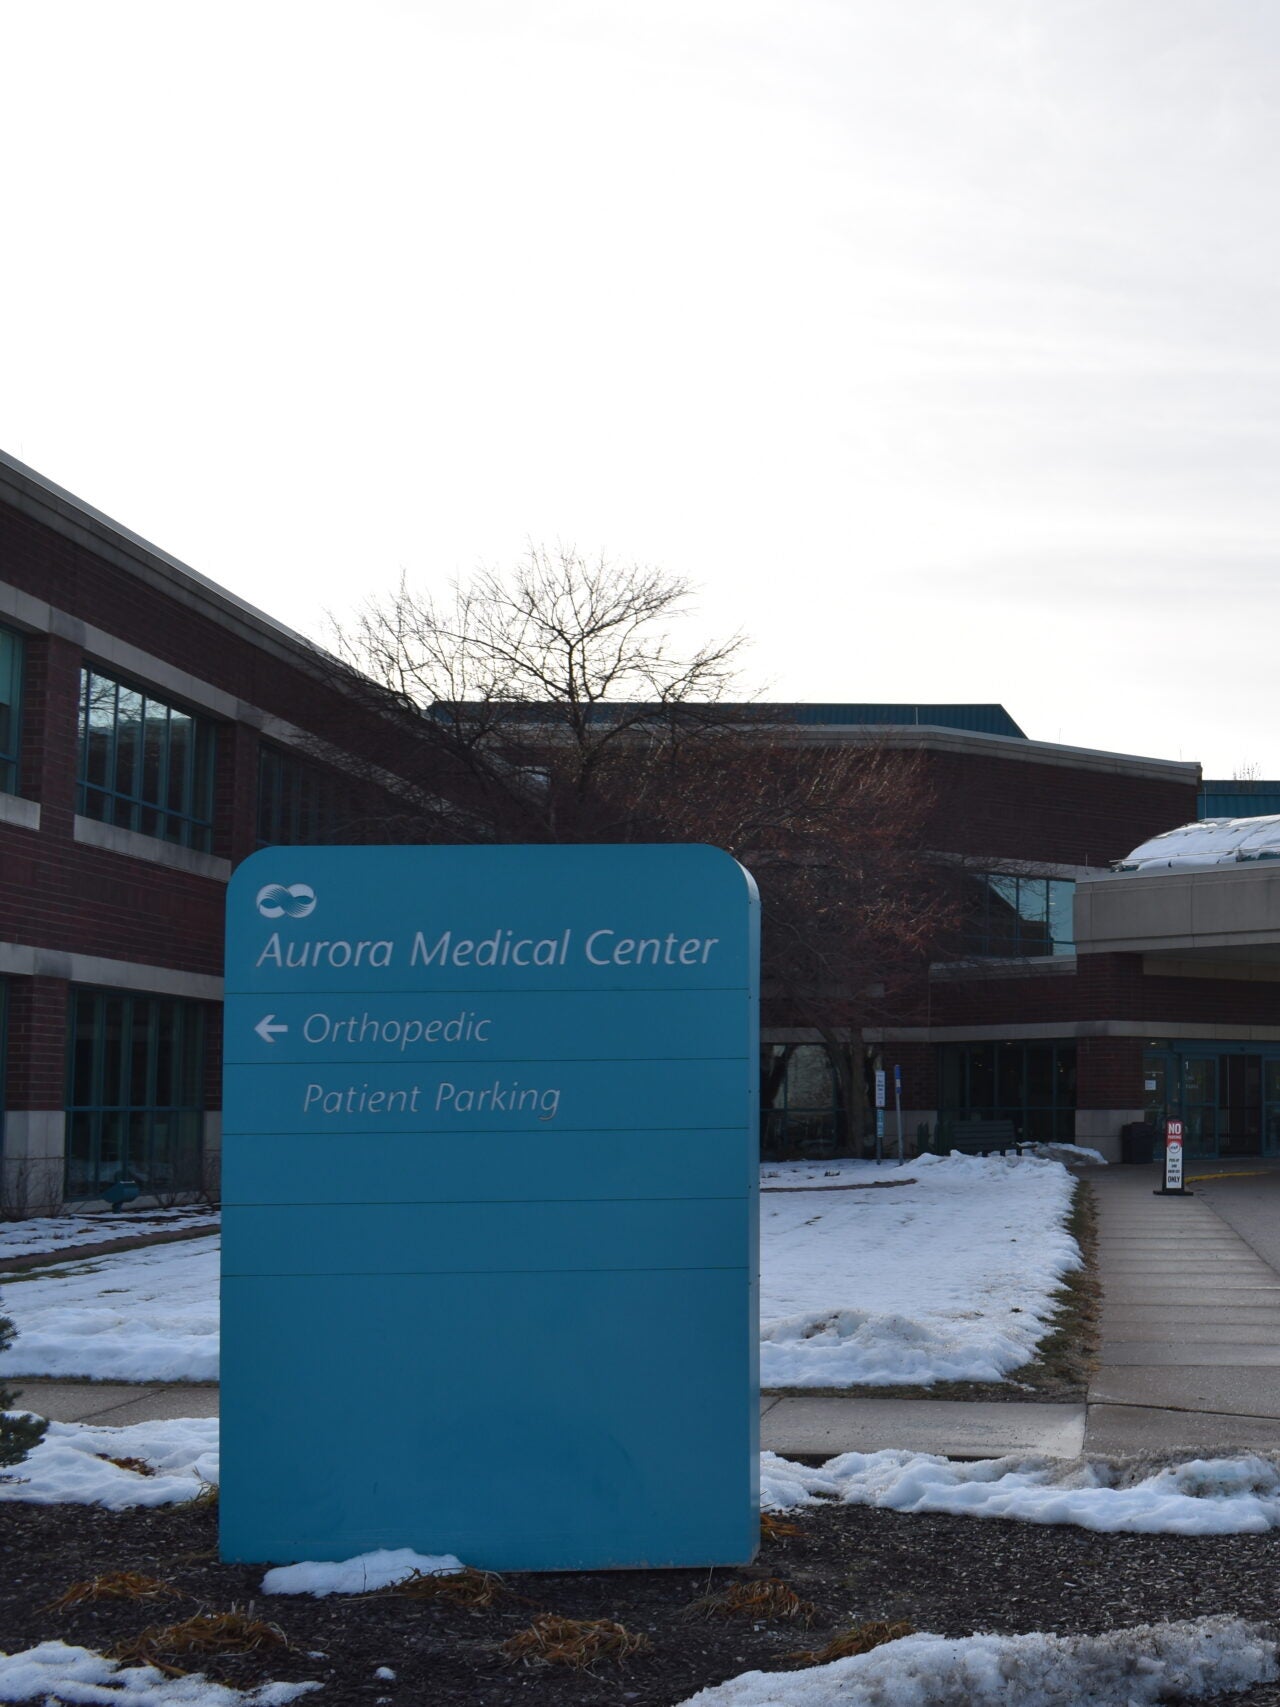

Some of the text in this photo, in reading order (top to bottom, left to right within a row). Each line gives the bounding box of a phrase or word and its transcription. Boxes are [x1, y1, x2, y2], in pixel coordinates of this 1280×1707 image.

[255, 928, 720, 968] Aurora Medical Center
[302, 1011, 492, 1051] Orthopedic
[302, 1080, 561, 1121] Patient Parking
[1168, 1123, 1181, 1134] NO
